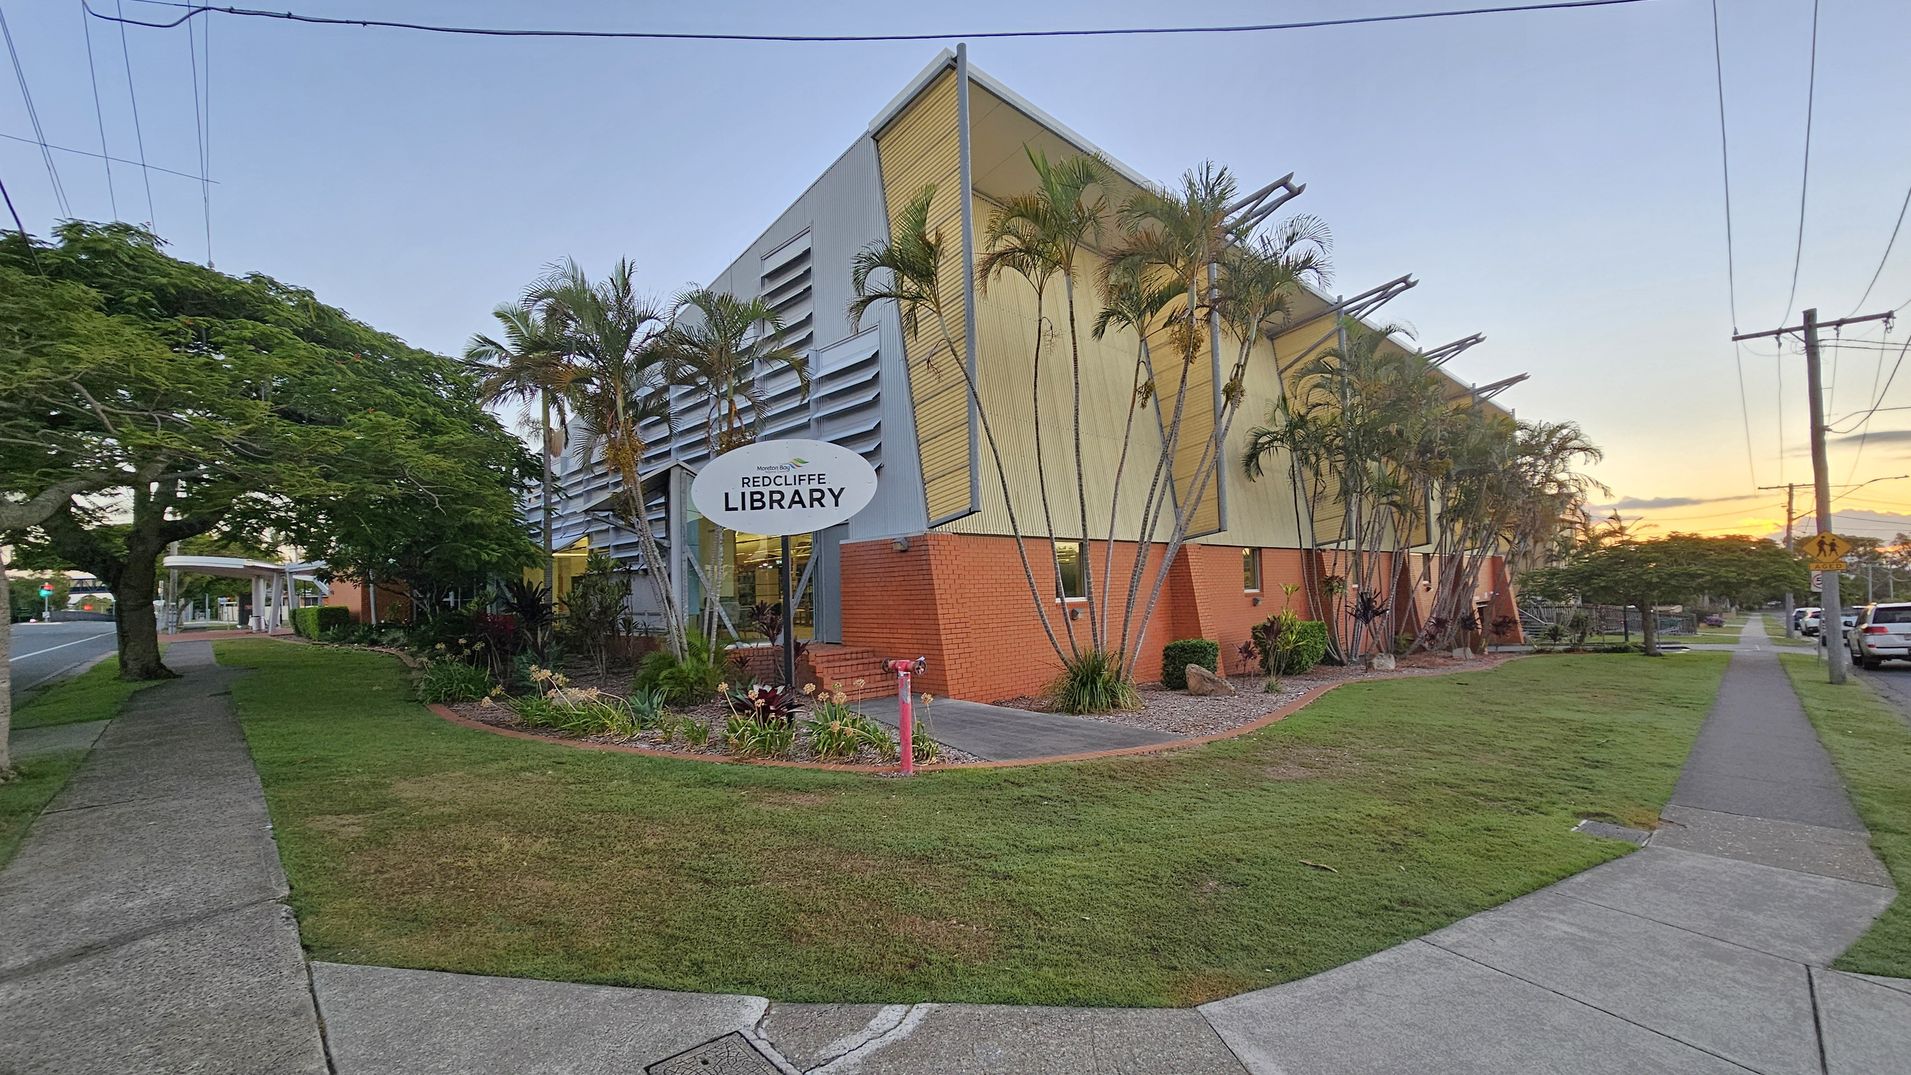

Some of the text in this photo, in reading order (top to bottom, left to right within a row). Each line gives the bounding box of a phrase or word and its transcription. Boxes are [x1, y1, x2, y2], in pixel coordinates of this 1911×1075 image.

[780, 464, 790, 472] Bay
[741, 473, 826, 488] REDCLIFFE
[724, 487, 845, 511] LIBRARY
